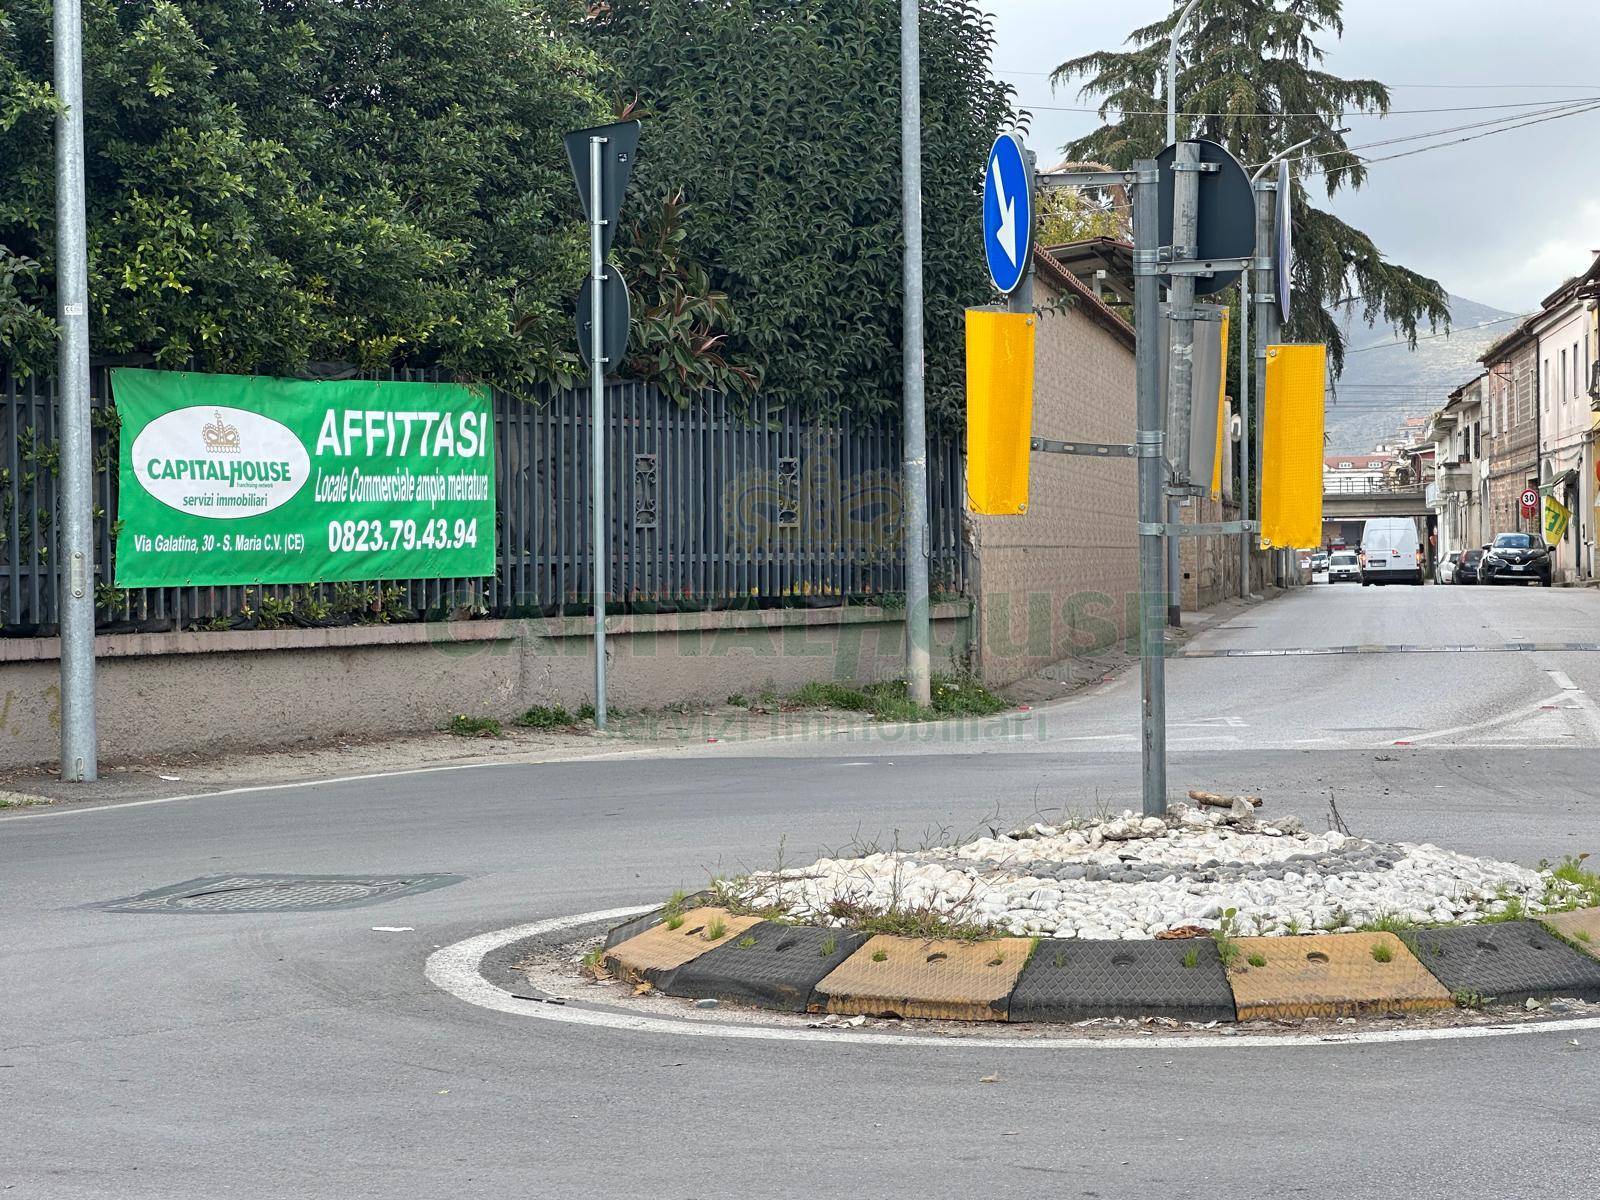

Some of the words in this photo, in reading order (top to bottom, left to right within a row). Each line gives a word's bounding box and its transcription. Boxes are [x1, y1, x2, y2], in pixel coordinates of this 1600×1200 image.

[316, 409, 487, 457] AFFITTASI
[147, 458, 292, 487] CAPITALHOUSE
[183, 493, 214, 506] servizi
[216, 493, 268, 507] immobiliari
[315, 467, 347, 502] Locale
[350, 466, 414, 503] Commerciale
[416, 467, 446, 510] ampia
[447, 469, 488, 501] metratura
[1524, 494, 1534, 502] 30
[134, 534, 152, 552] Via
[155, 534, 199, 553] Galatina,
[202, 534, 215, 551] 30
[223, 534, 233, 550] S.
[235, 533, 262, 550] Maria
[264, 533, 283, 550] C.V.
[284, 533, 305, 554] (CE)
[328, 518, 477, 552] 0823.79.43.94
